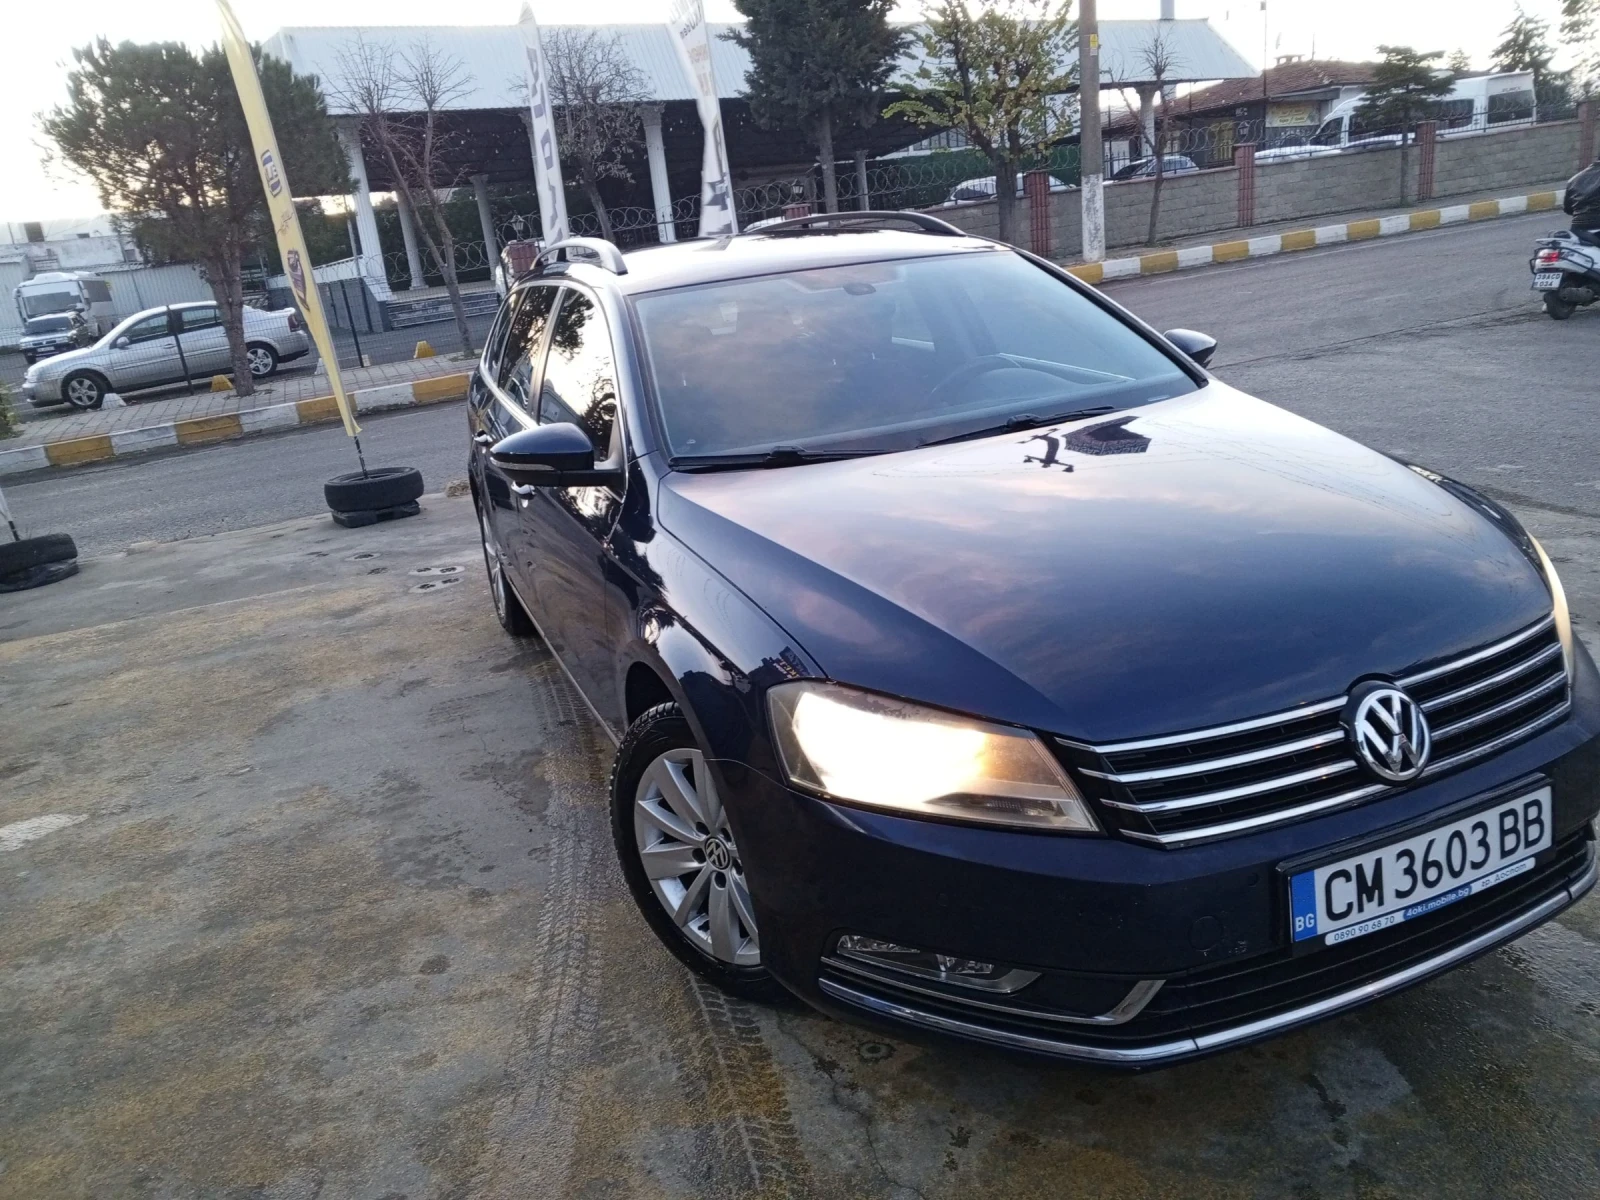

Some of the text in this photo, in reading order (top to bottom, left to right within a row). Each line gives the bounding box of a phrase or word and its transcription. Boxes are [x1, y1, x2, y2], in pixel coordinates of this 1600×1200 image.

[1355, 688, 1430, 781] VW
[1325, 798, 1545, 922] CM 3603 BB
[1406, 887, 1470, 917] 4oki.mobile.bg
[1295, 913, 1315, 933] BG
[1333, 915, 1395, 942] 0890 90 68 70
